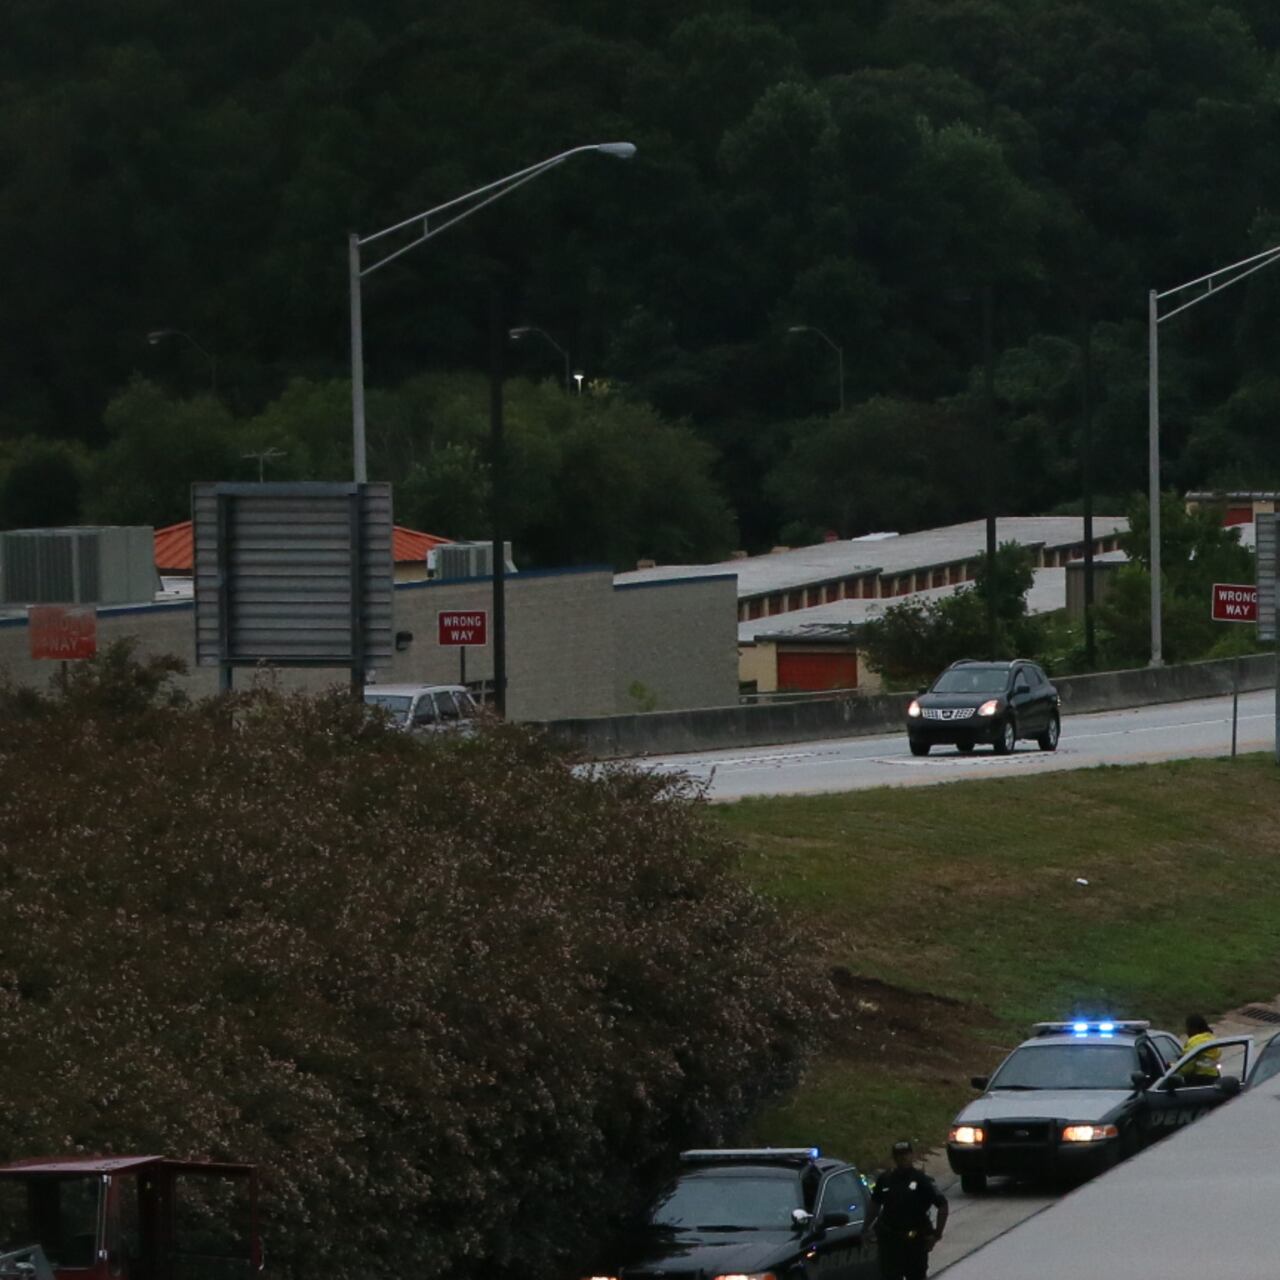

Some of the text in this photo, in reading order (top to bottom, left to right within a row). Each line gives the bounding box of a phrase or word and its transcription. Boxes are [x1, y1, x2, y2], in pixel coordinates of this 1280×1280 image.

[1218, 590, 1257, 603] WRONG
[1225, 603, 1250, 616] WAY
[443, 615, 482, 627] WRONG
[450, 630, 475, 641] WAY
